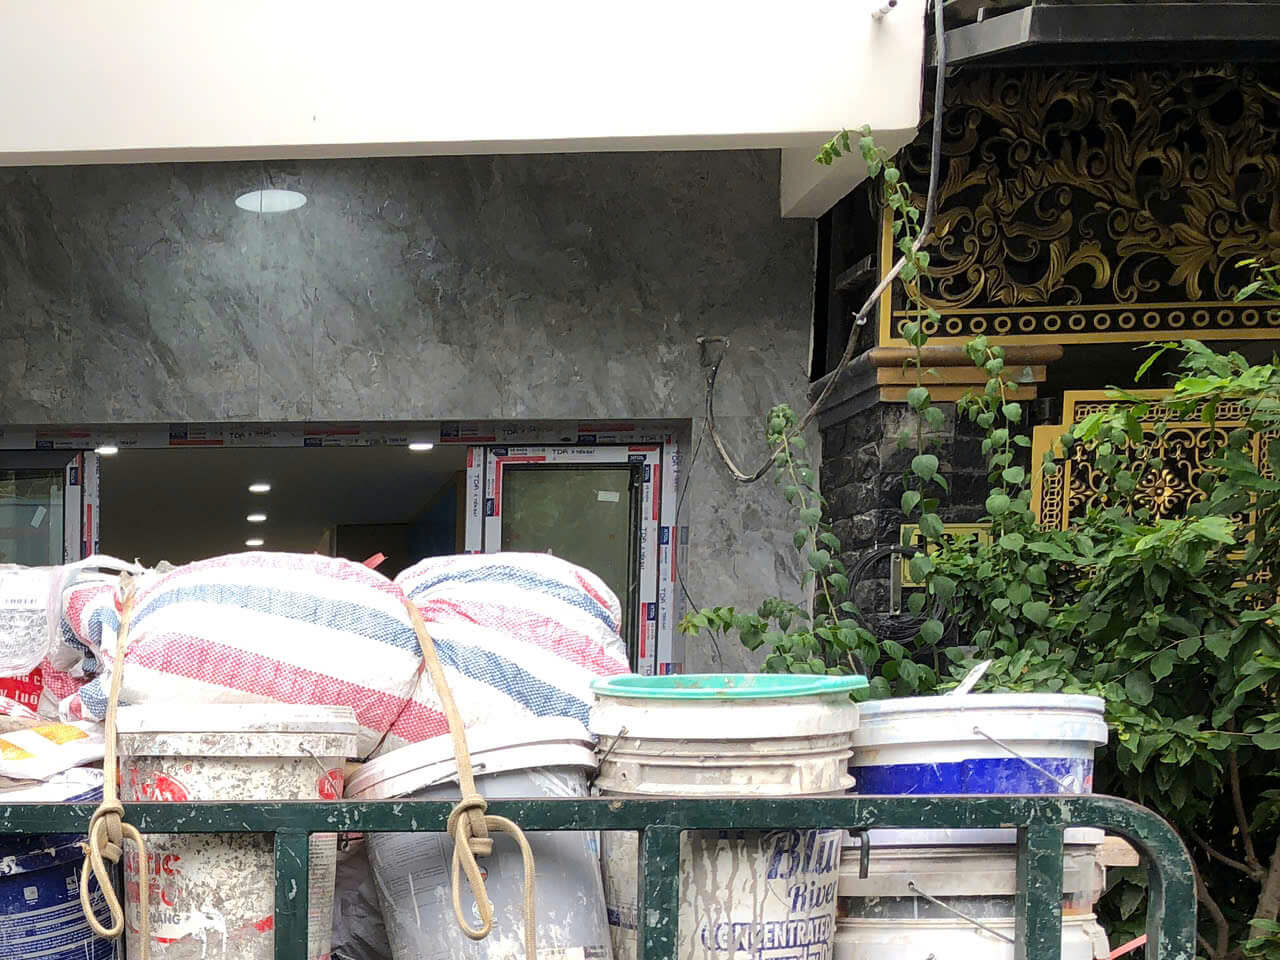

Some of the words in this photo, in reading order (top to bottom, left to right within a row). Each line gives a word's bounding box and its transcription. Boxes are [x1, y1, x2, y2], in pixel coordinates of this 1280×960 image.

[767, 829, 838, 880] Blu
[788, 879, 838, 913] Rive
[700, 914, 833, 952] CONENTRATED
